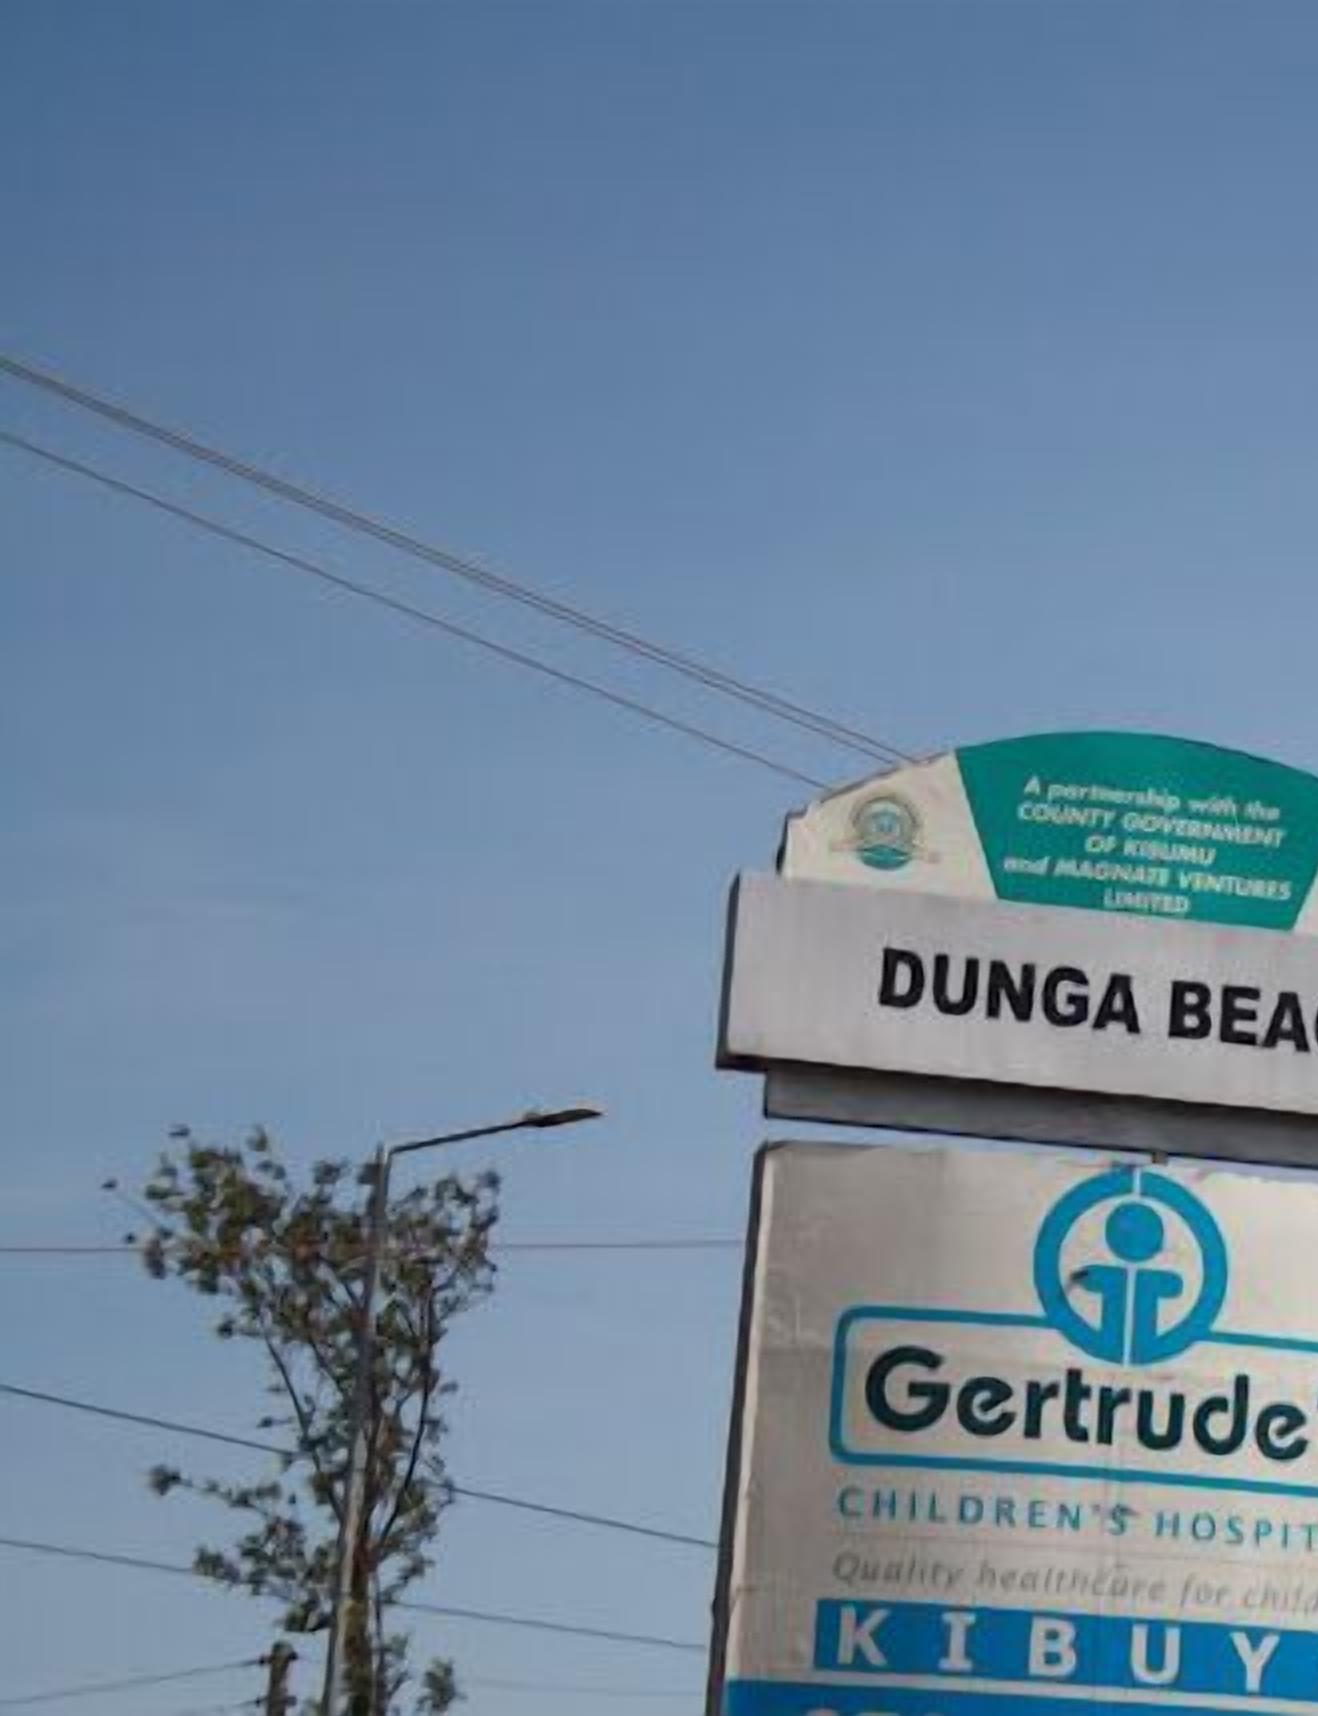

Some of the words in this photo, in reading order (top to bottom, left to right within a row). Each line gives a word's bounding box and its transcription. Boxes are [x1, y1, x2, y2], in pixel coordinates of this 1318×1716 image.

[1024, 776, 1041, 795] A
[1048, 784, 1180, 813] partnership
[1188, 797, 1238, 817] with
[1245, 800, 1280, 821] the
[1017, 802, 1115, 828] COUNTY
[1122, 812, 1286, 848] GOVERNMENT
[1085, 834, 1116, 853] OF
[1123, 839, 1216, 866] KISUMU
[1004, 855, 1049, 875] and
[1053, 858, 1170, 886] MAGNATE
[1179, 871, 1292, 900] VENTURES
[1103, 887, 1190, 914] LIMITED
[878, 946, 1141, 1035] DUNGA
[838, 1485, 1130, 1536] CHILDREN'S
[832, 1551, 963, 1588] Quality
[976, 1554, 1163, 1601] healthcare
[1178, 1578, 1224, 1610] for
